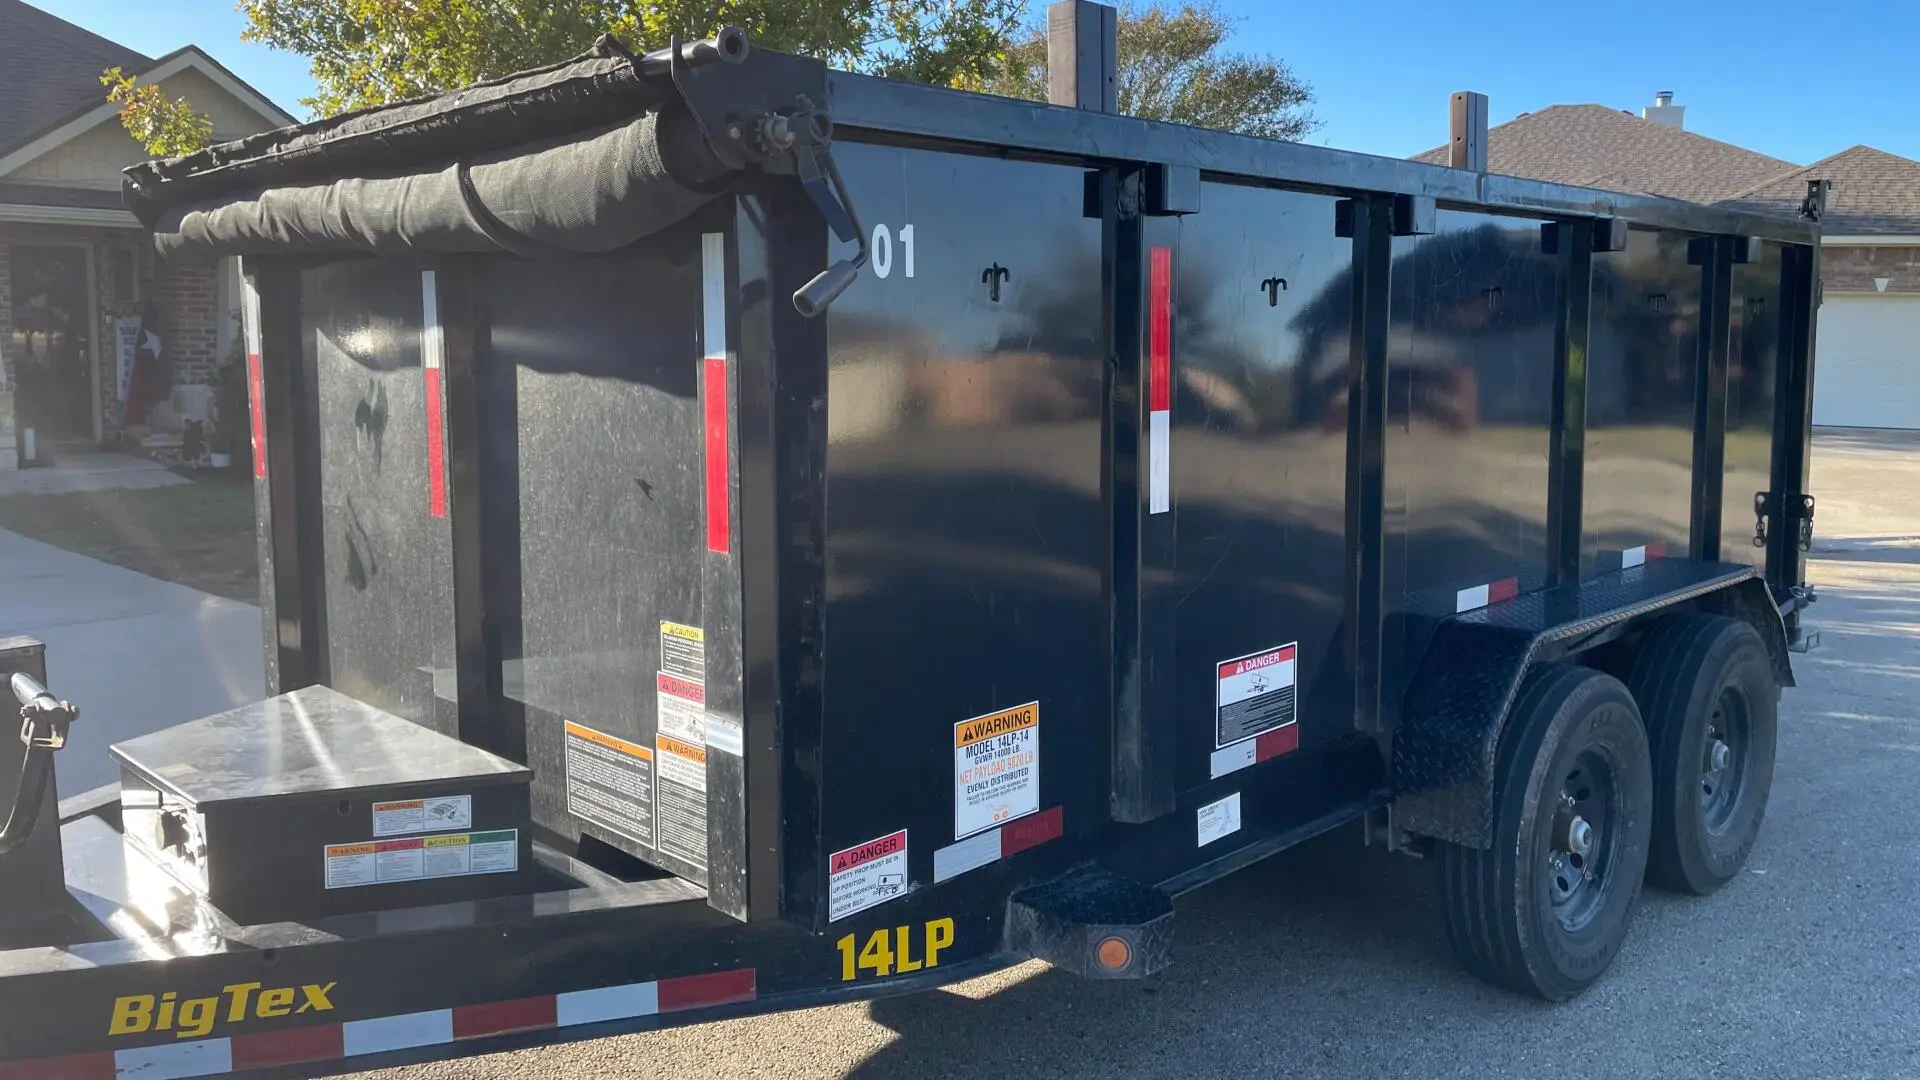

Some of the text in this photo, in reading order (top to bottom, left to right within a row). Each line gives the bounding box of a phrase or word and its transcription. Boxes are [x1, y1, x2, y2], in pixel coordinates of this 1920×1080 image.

[872, 224, 914, 278] 01
[675, 628, 699, 639] CAUTION
[1245, 652, 1280, 671] DANGER
[974, 710, 1031, 738] WARNING
[674, 744, 705, 761] WARNING
[966, 730, 1029, 759] MODEL 14LP-14
[975, 744, 1020, 765] GVWR 14000 LB
[960, 769, 972, 785] NET
[975, 759, 1005, 778] PAYLOAD
[1008, 754, 1024, 769] 9820
[967, 767, 1029, 794] EVENLY DISTRIBUTED
[331, 846, 371, 855] WARNING
[434, 837, 467, 846] CAUTION
[851, 838, 897, 864] DANGER
[833, 872, 853, 883] SAFETY
[855, 865, 869, 875] PROP
[870, 860, 885, 869] MUST
[833, 883, 877, 904] BEFORE WORKING
[841, 877, 865, 890] POSITION
[832, 903, 852, 914] UNDER
[836, 917, 954, 981] 14LP
[108, 981, 338, 1038] BigTex
